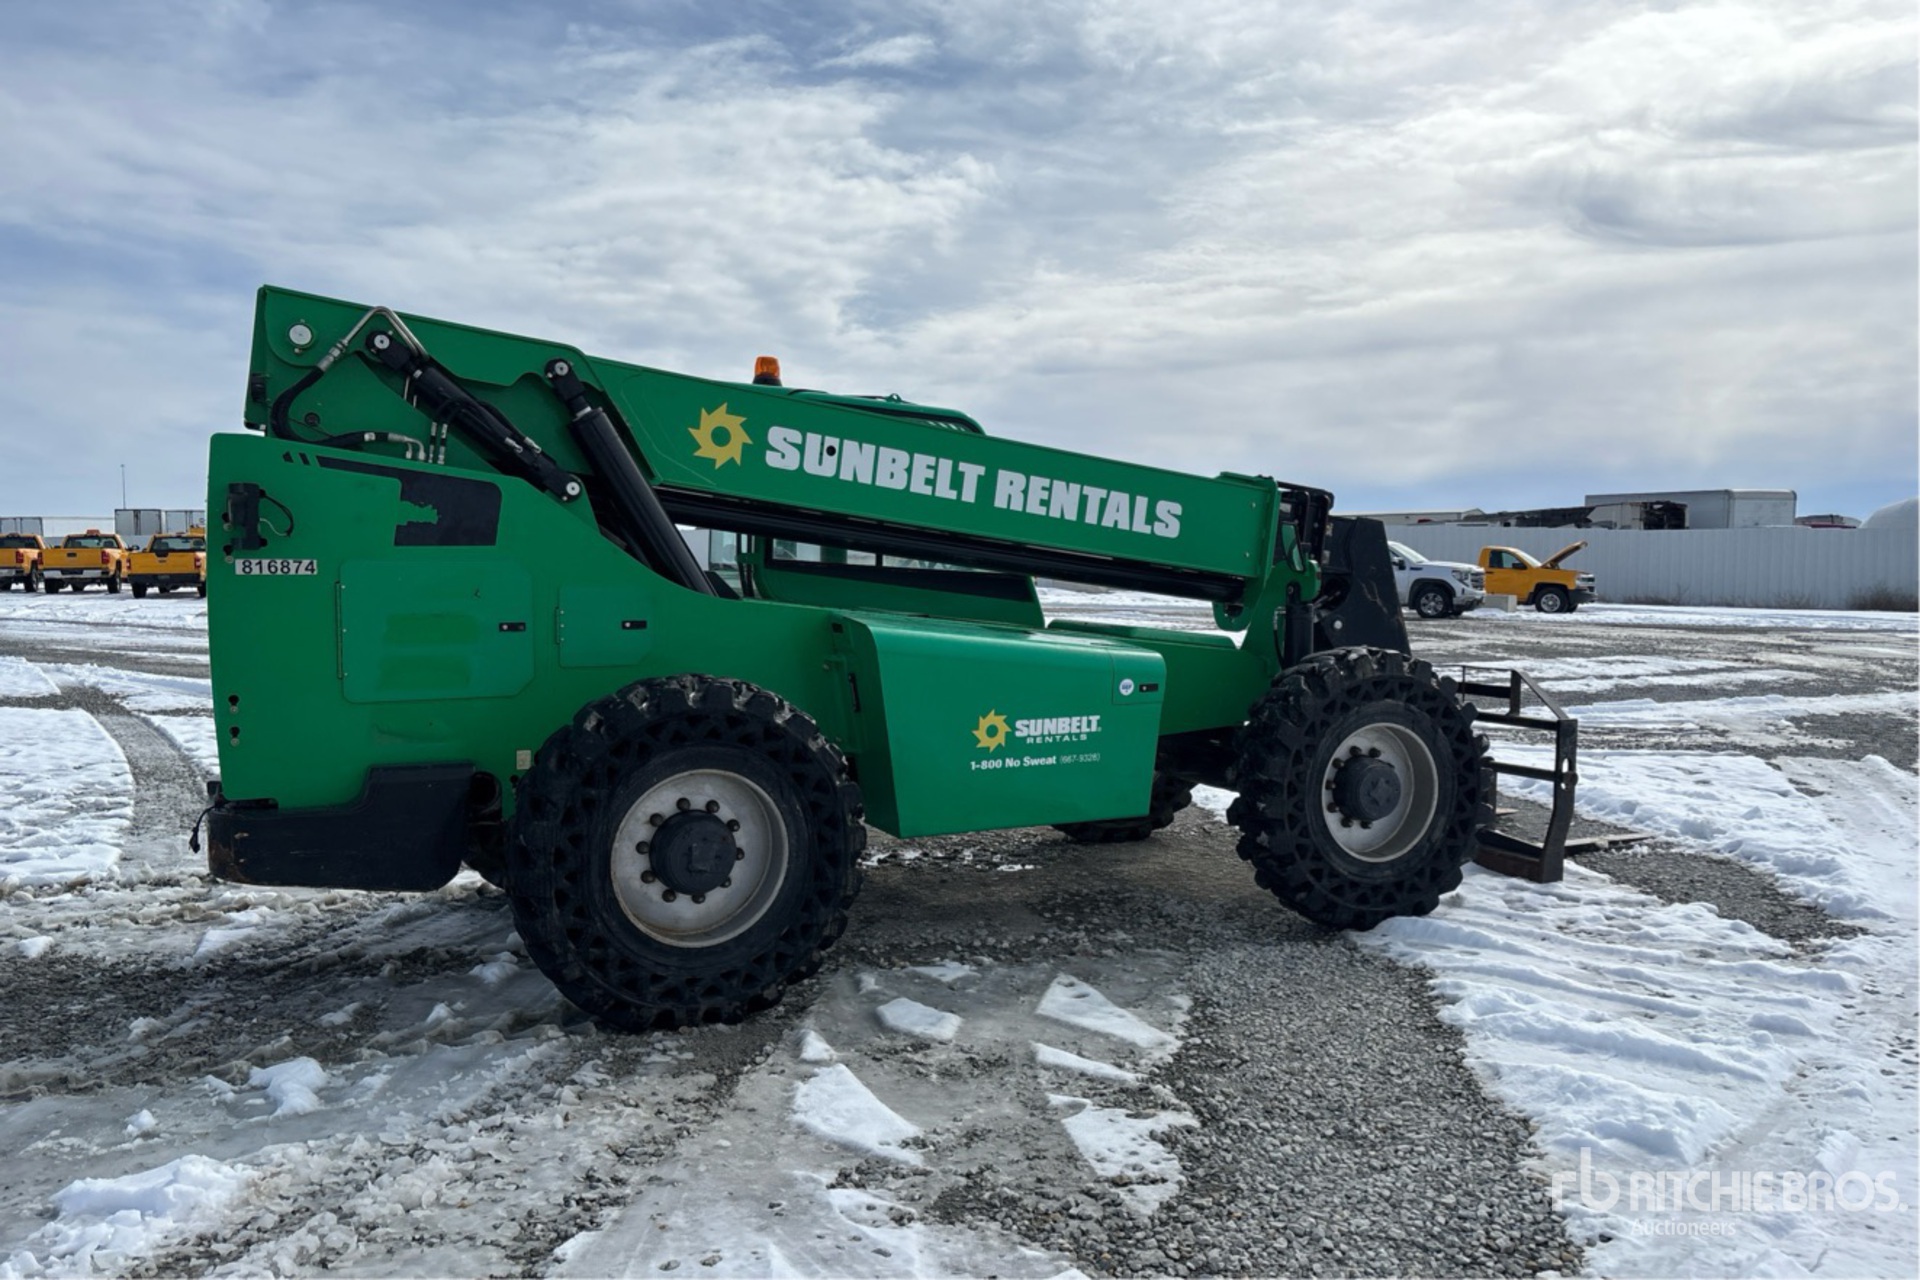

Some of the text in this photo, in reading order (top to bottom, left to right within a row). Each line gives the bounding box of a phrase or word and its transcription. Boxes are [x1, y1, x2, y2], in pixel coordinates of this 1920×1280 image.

[765, 426, 1183, 539] SUNBELT RENTALS
[241, 559, 316, 574] 816874
[1026, 734, 1087, 744] RENTALS
[970, 760, 1002, 770] 1-800
[1005, 758, 1021, 768] No
[1023, 755, 1057, 767] Sweat
